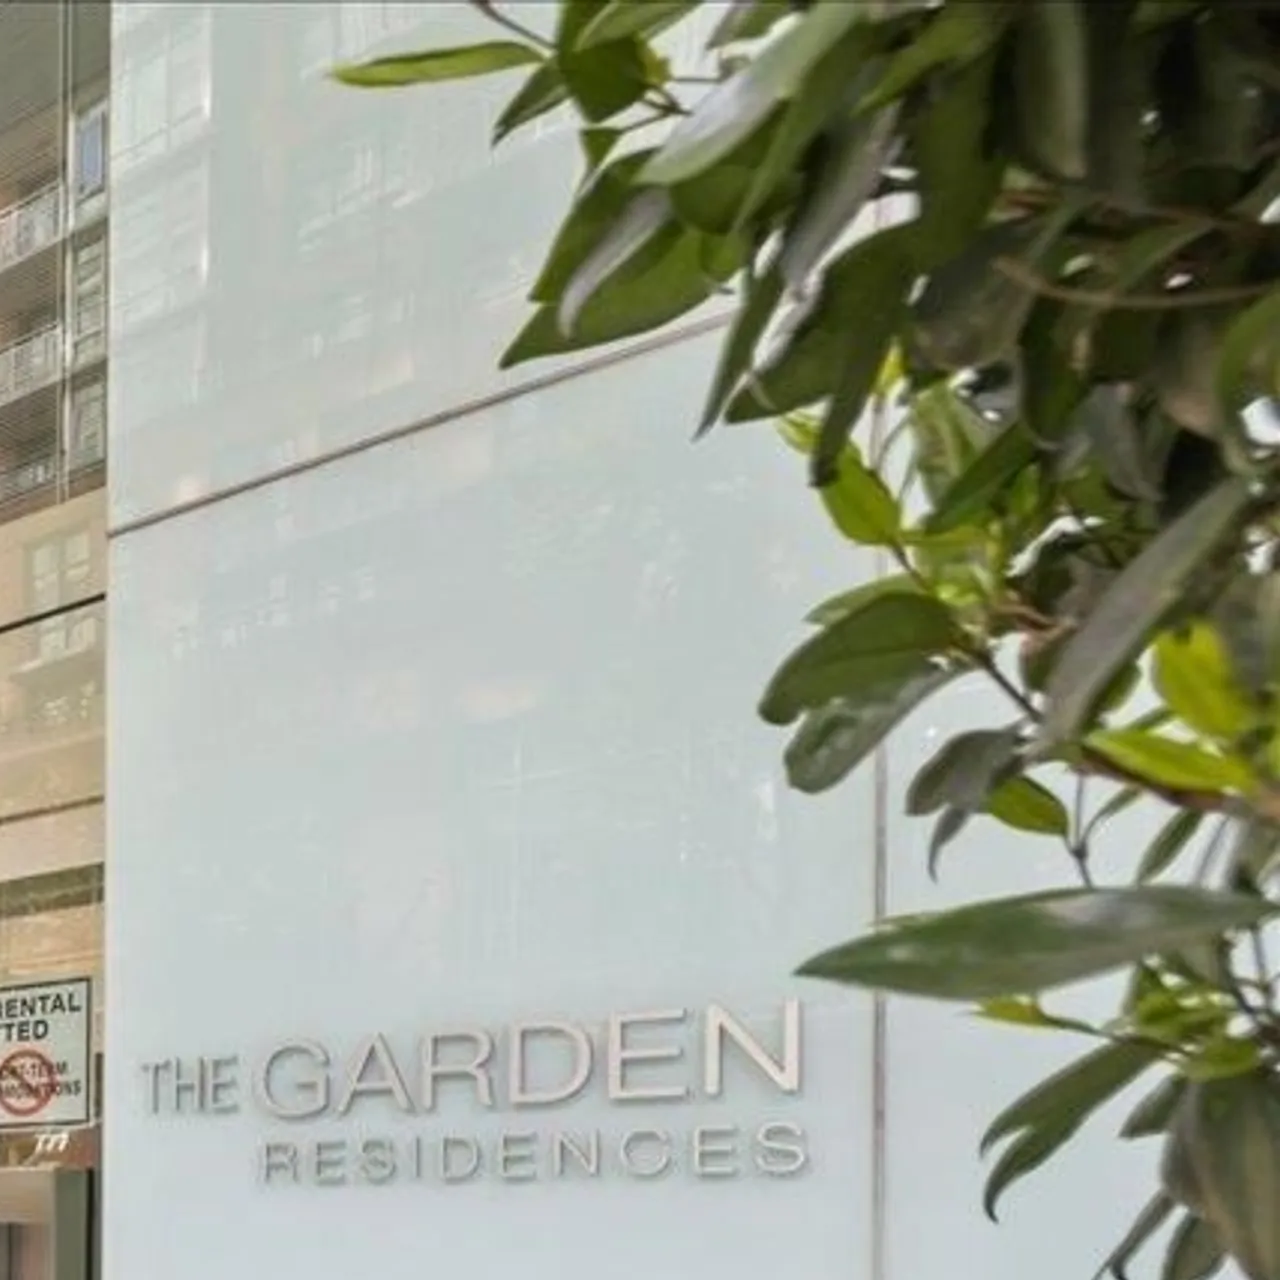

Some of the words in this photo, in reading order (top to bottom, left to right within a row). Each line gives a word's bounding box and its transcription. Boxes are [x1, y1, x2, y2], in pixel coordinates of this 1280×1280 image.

[140, 1054, 240, 1117] THE
[262, 997, 806, 1121] GARDEN
[263, 1123, 809, 1185] RESIDENCES
